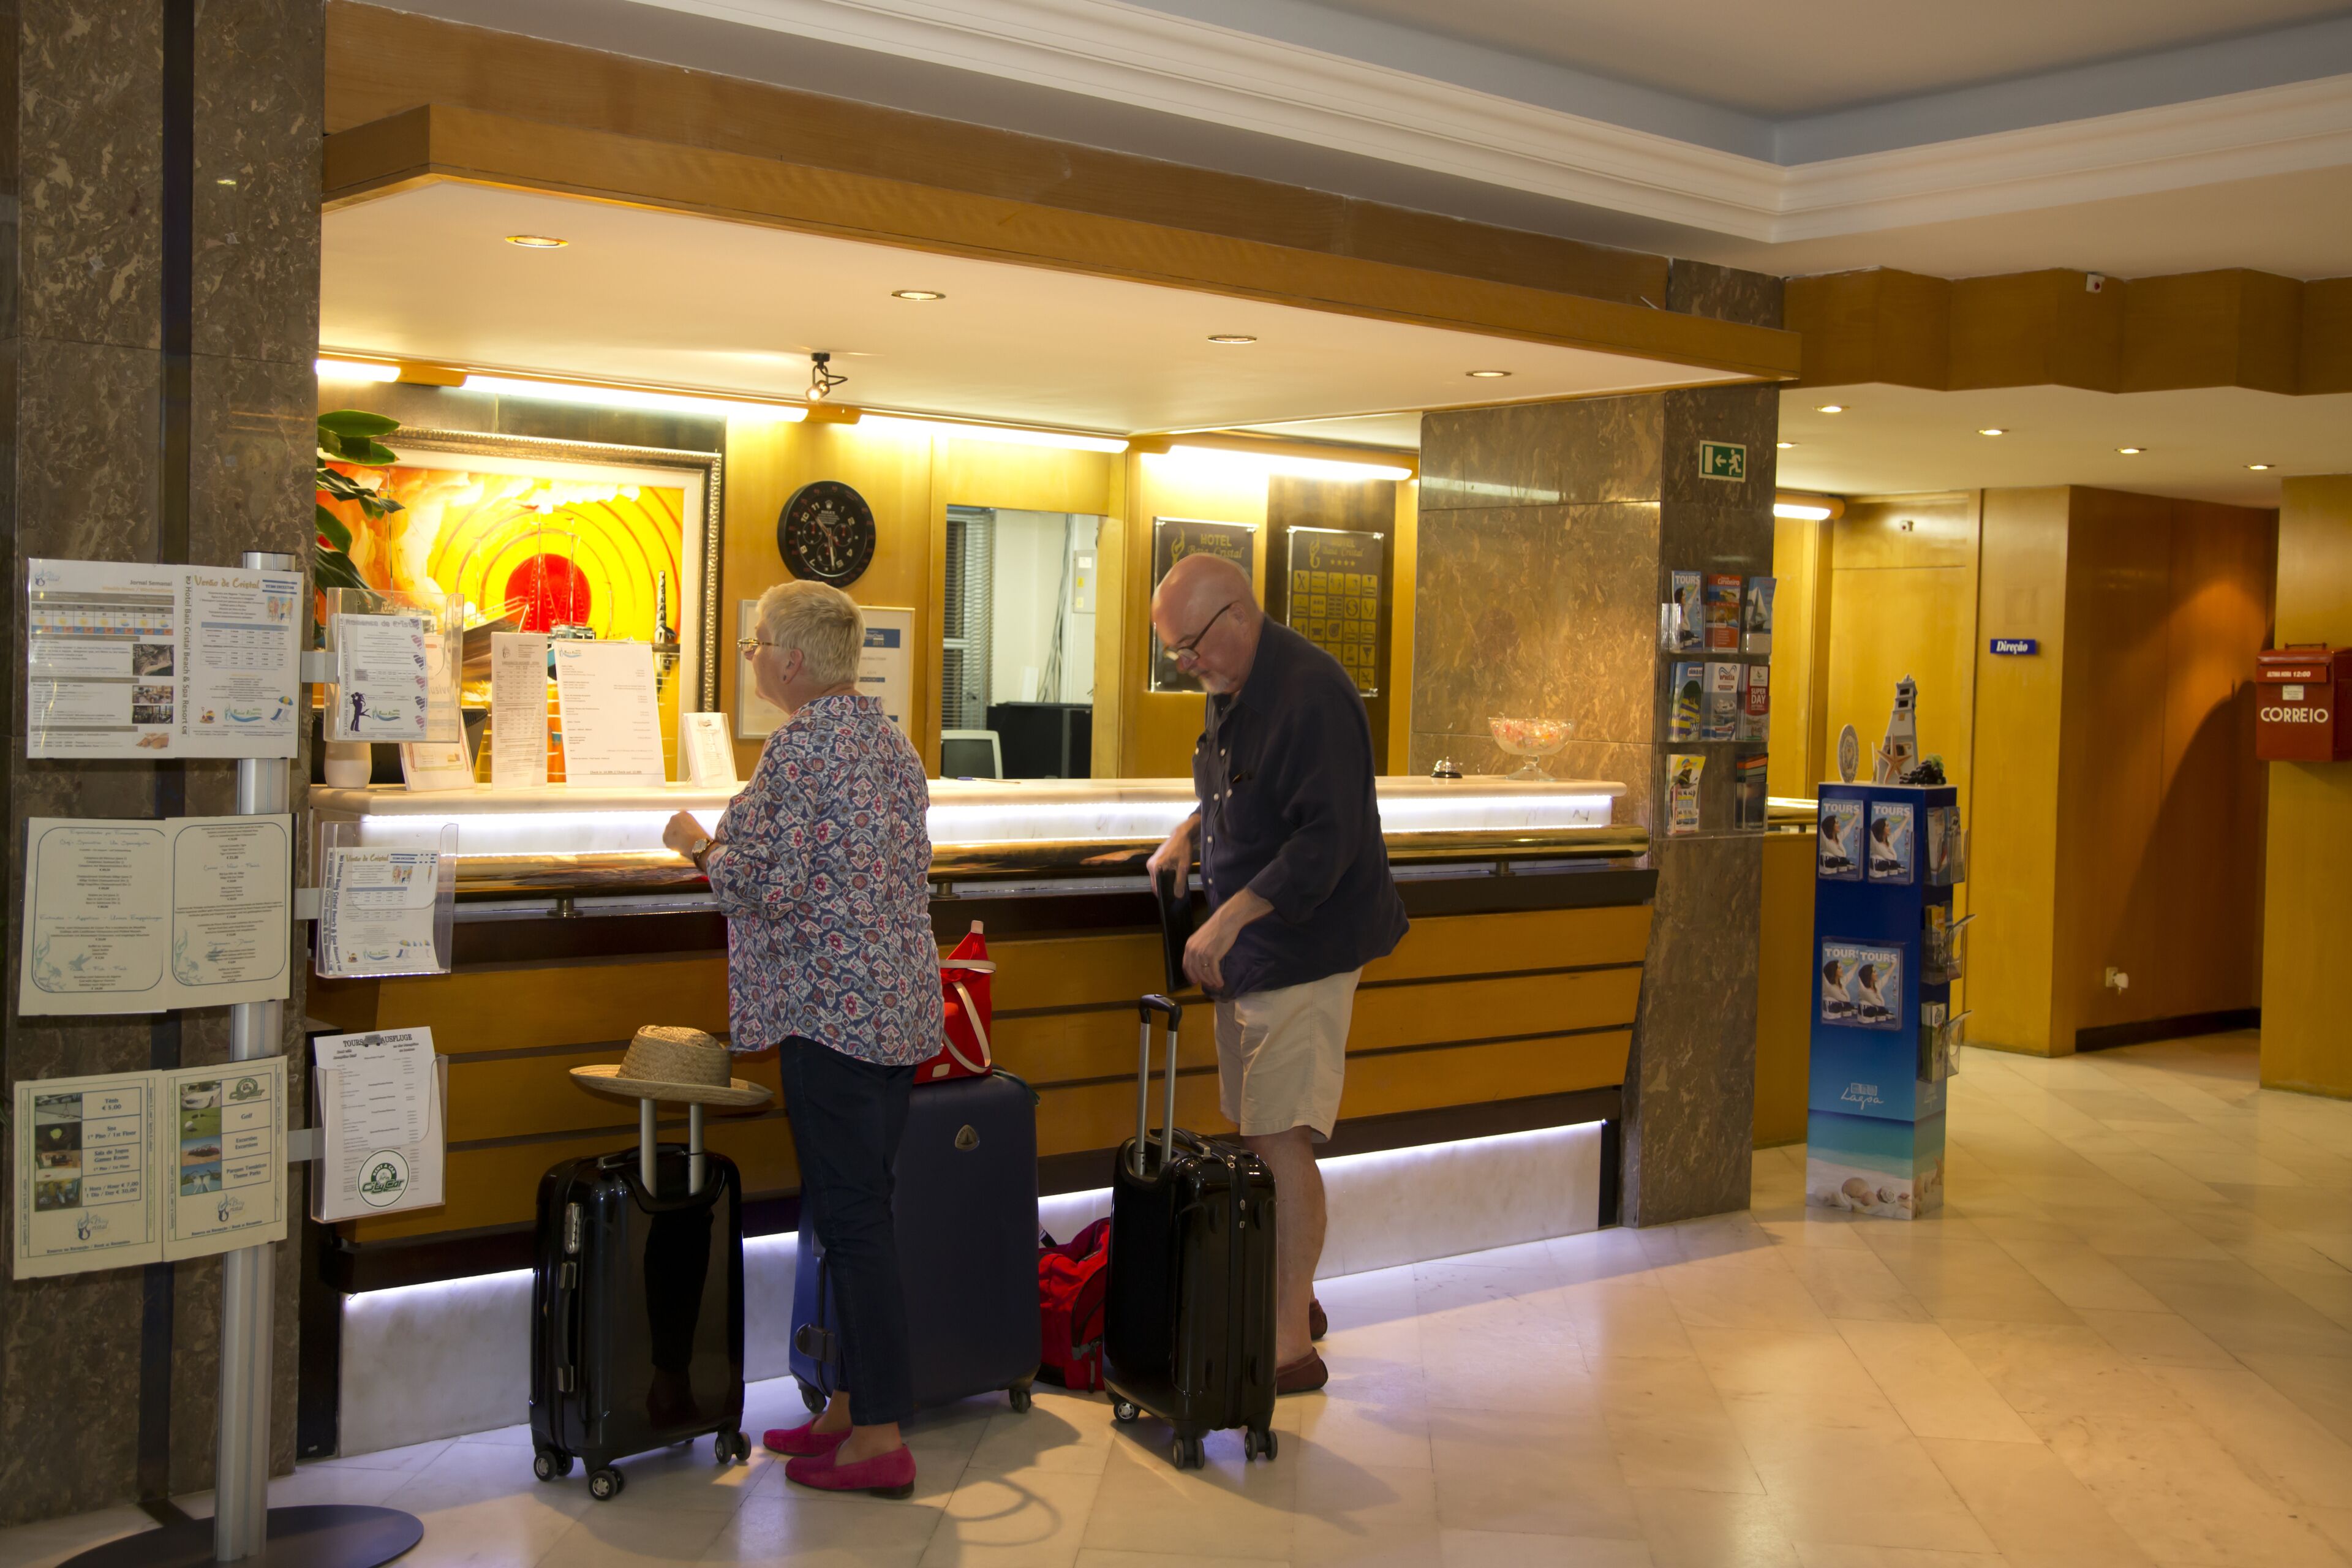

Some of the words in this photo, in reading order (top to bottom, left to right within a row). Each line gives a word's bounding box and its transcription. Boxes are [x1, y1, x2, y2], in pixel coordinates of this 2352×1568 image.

[1200, 533, 1232, 546] HOTEL
[1332, 537, 1355, 548] HOTEL
[1341, 547, 1365, 557] Cristal
[222, 578, 230, 588] de
[233, 578, 260, 589] Cristal
[1675, 576, 1700, 584] TOURS
[1751, 695, 1766, 704] DAY
[2261, 707, 2329, 723] CORREIO
[1823, 803, 1860, 813] TOURS
[1874, 805, 1910, 816] TOURS
[370, 853, 390, 862] Cristal
[1860, 951, 1897, 962] TOURS
[343, 1039, 363, 1047] TOURS
[381, 1034, 412, 1044] AUSFLUGE
[1841, 1087, 1884, 1110] Lagoa
